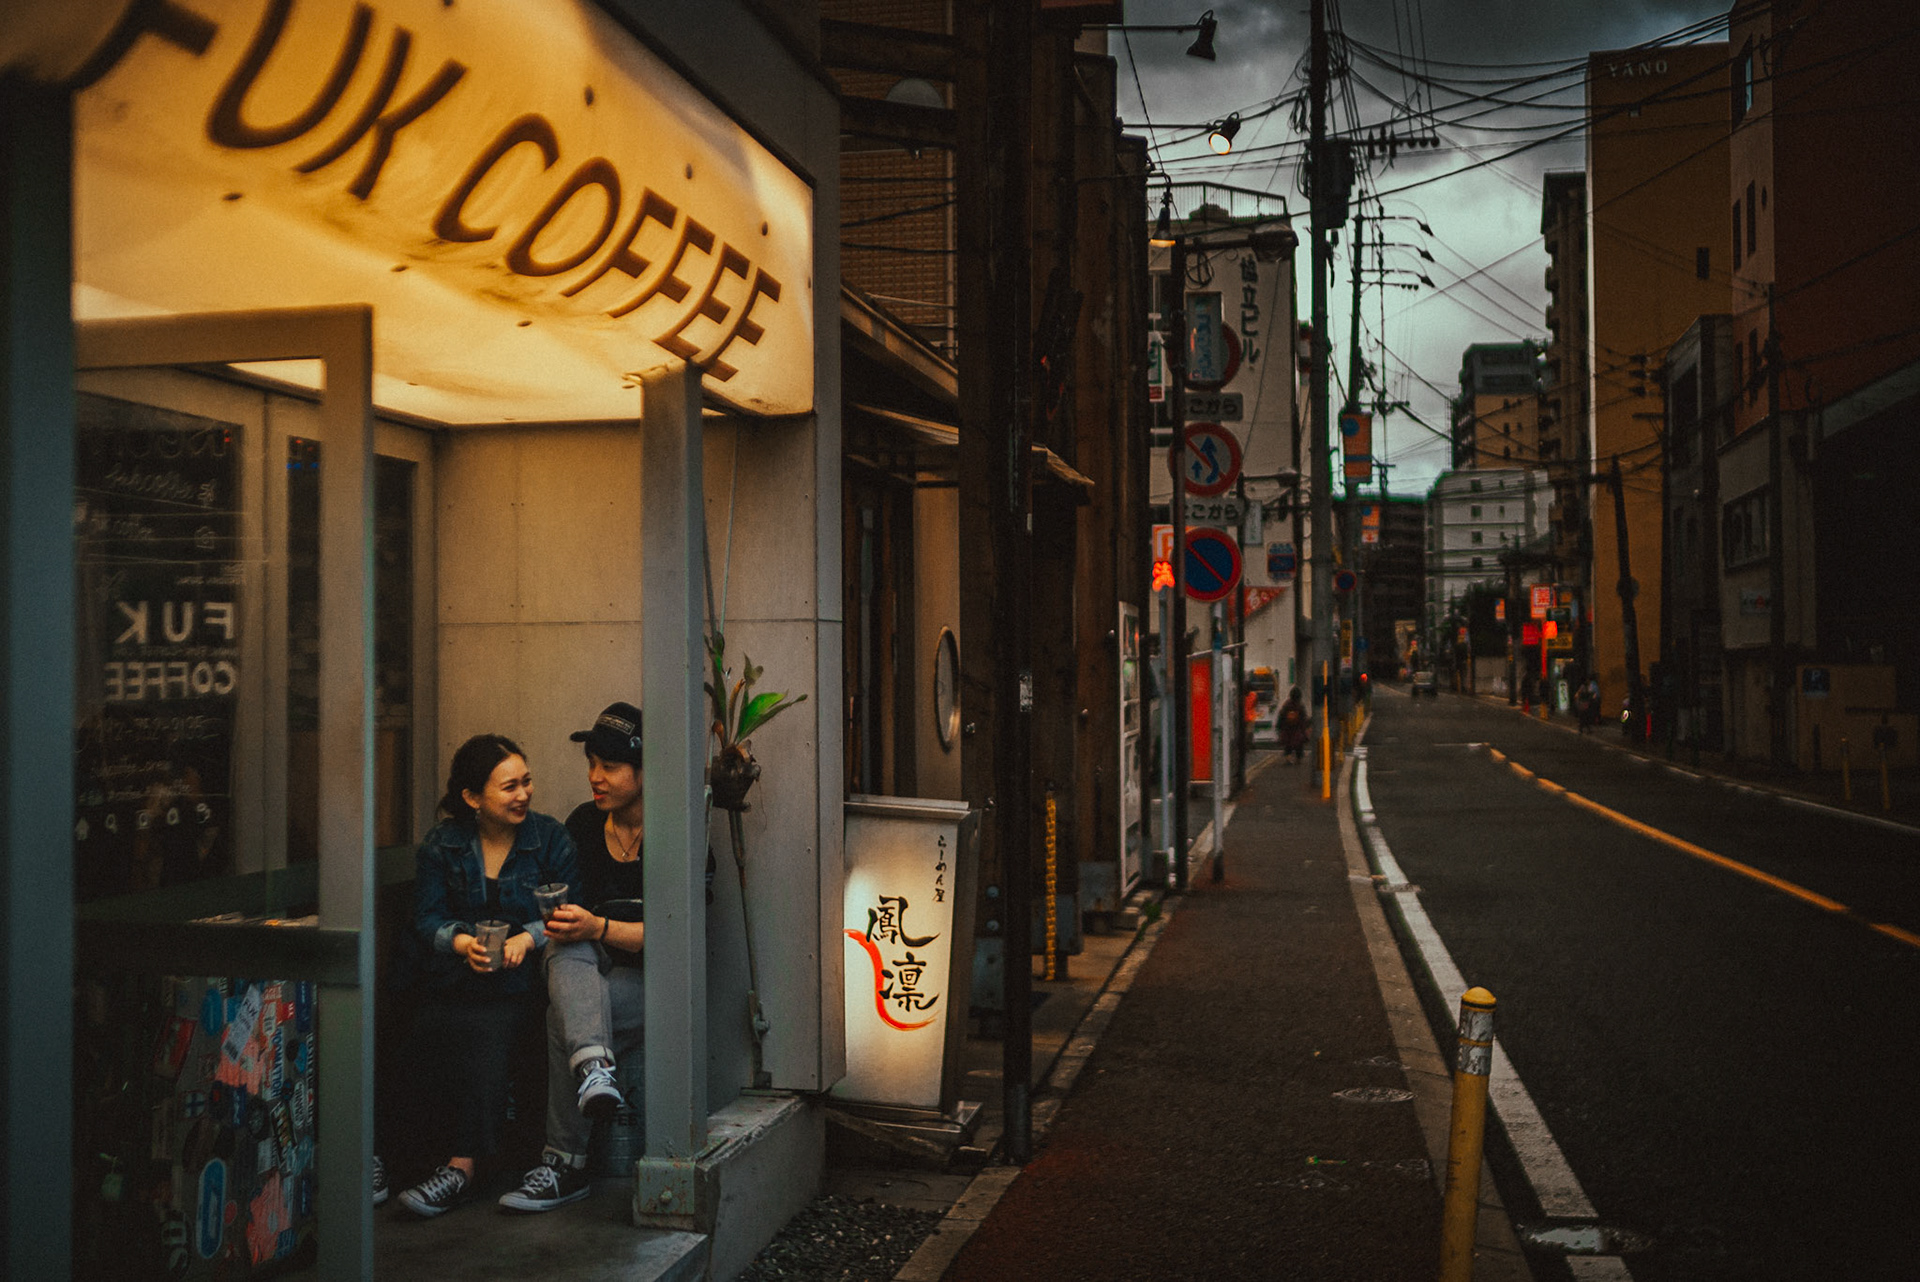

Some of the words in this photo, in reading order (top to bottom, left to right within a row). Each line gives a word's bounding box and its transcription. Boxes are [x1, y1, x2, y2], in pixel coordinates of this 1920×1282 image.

[1608, 60, 1669, 78] YANO
[430, 113, 783, 383] COFFEE
[1183, 397, 1238, 416] こから
[1184, 503, 1239, 521] こから
[932, 835, 947, 903] らーめん屋
